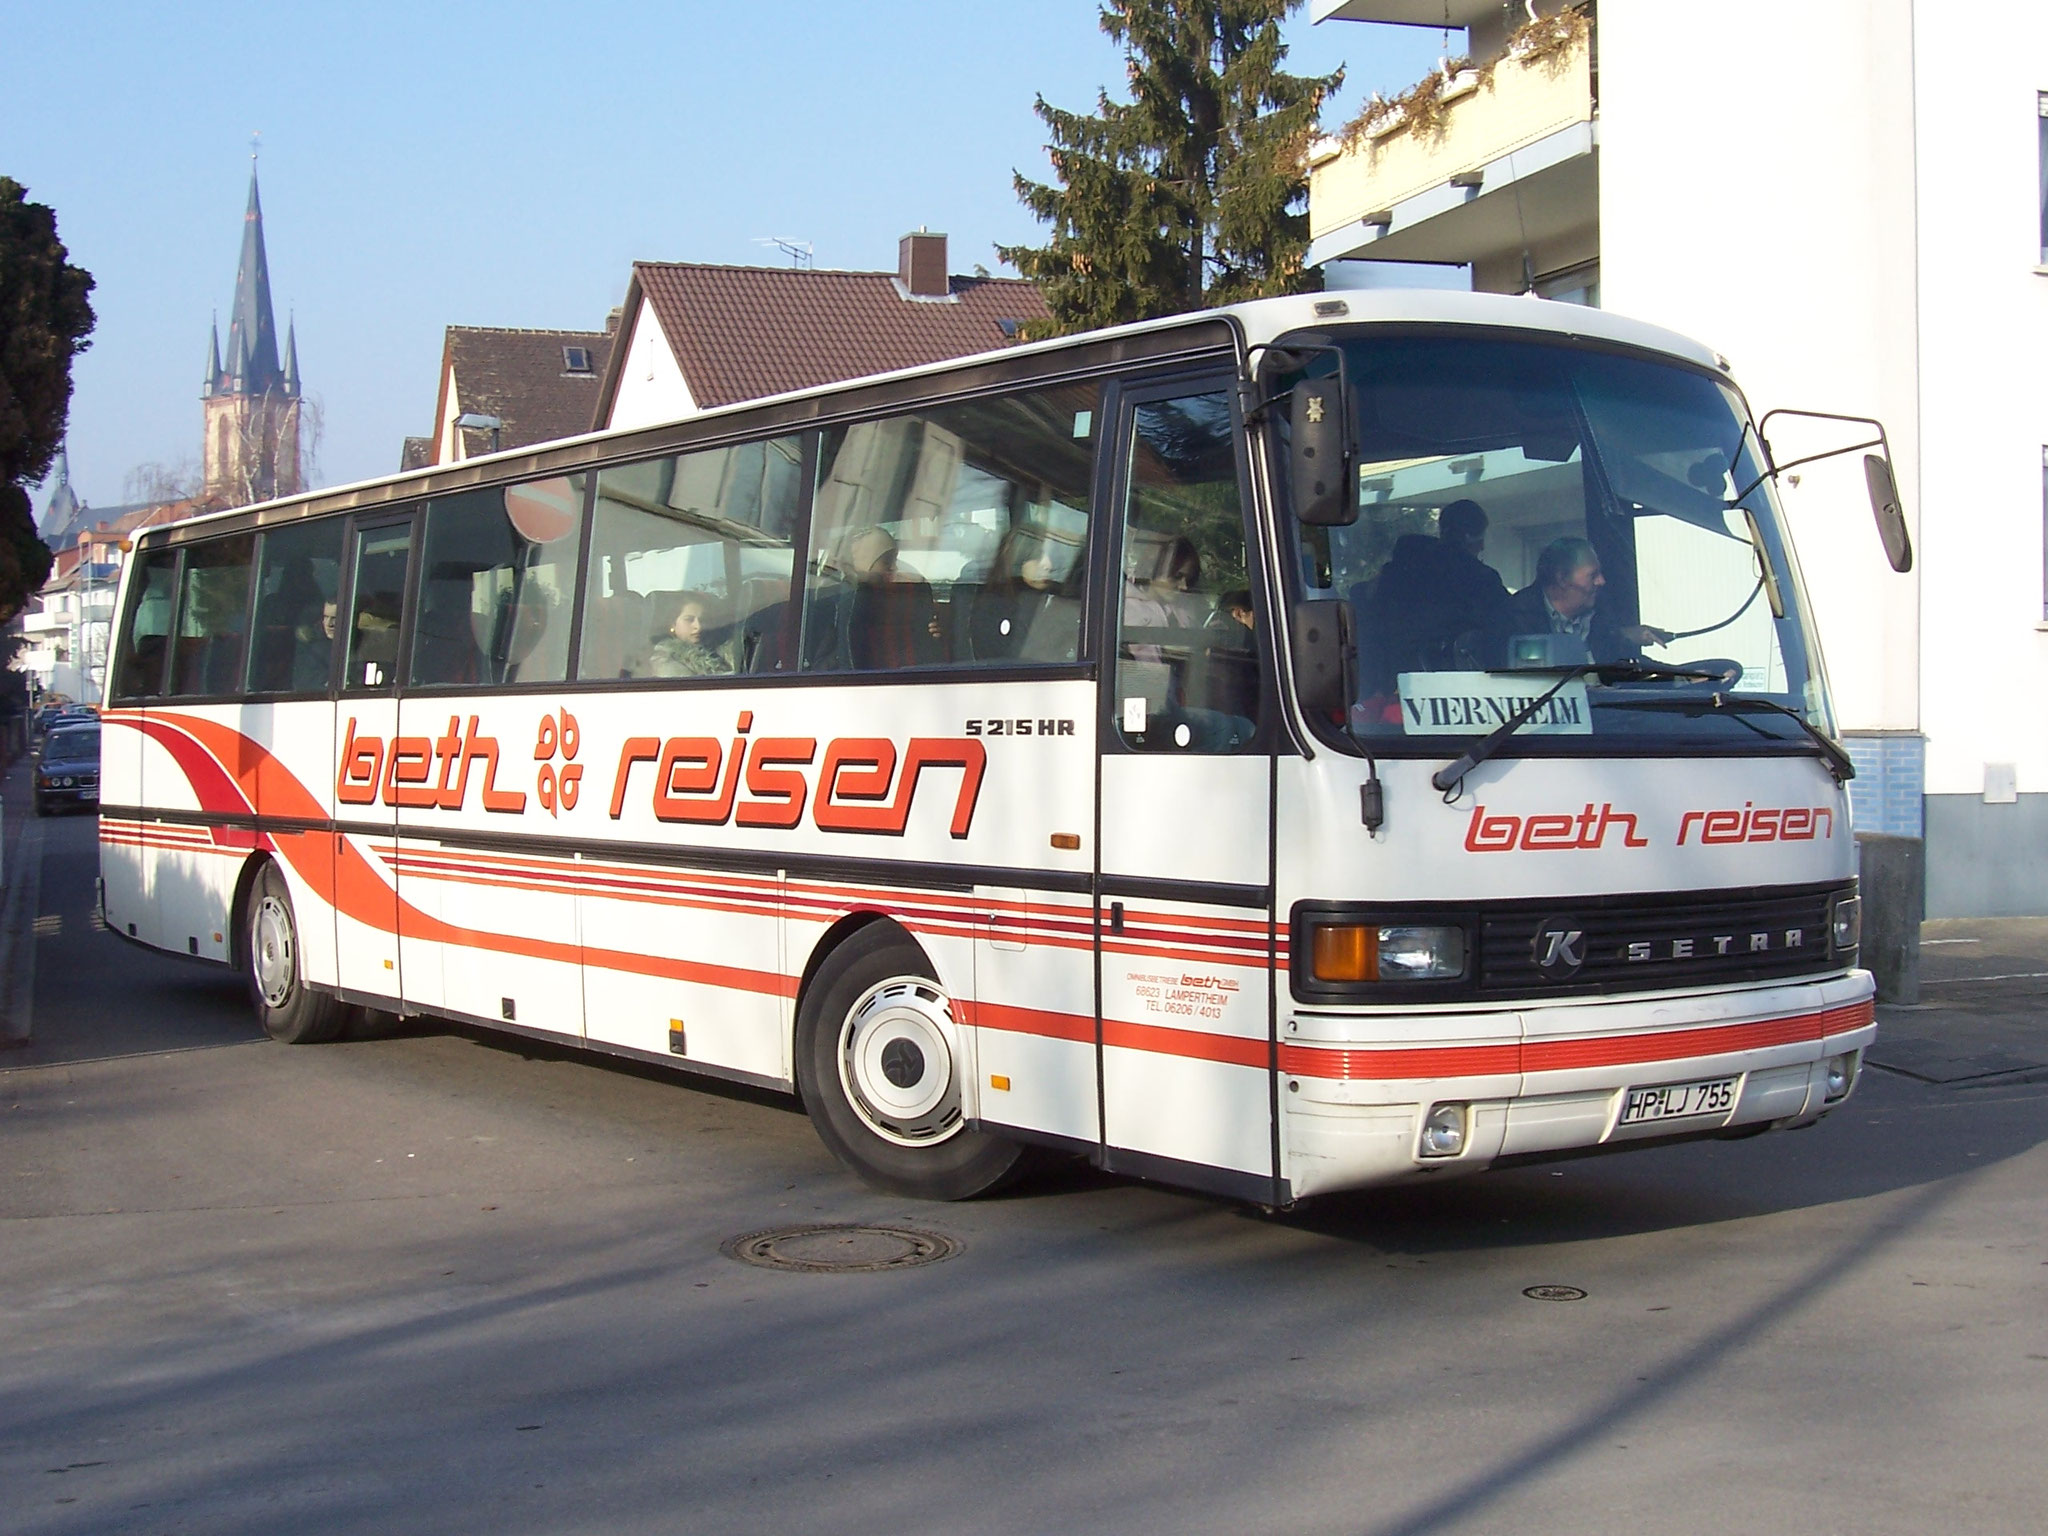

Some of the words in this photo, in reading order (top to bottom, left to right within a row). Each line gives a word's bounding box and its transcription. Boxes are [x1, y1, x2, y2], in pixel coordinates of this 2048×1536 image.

[337, 716, 526, 814] beth
[610, 711, 987, 840] reisen
[1465, 803, 1648, 852] beth
[1677, 801, 1833, 846] reisen
[1628, 929, 1803, 962] SETRA
[1165, 989, 1228, 1005] LAMPERTHEIM
[1181, 974, 1239, 991] beth
[1696, 1082, 1732, 1111] 755
